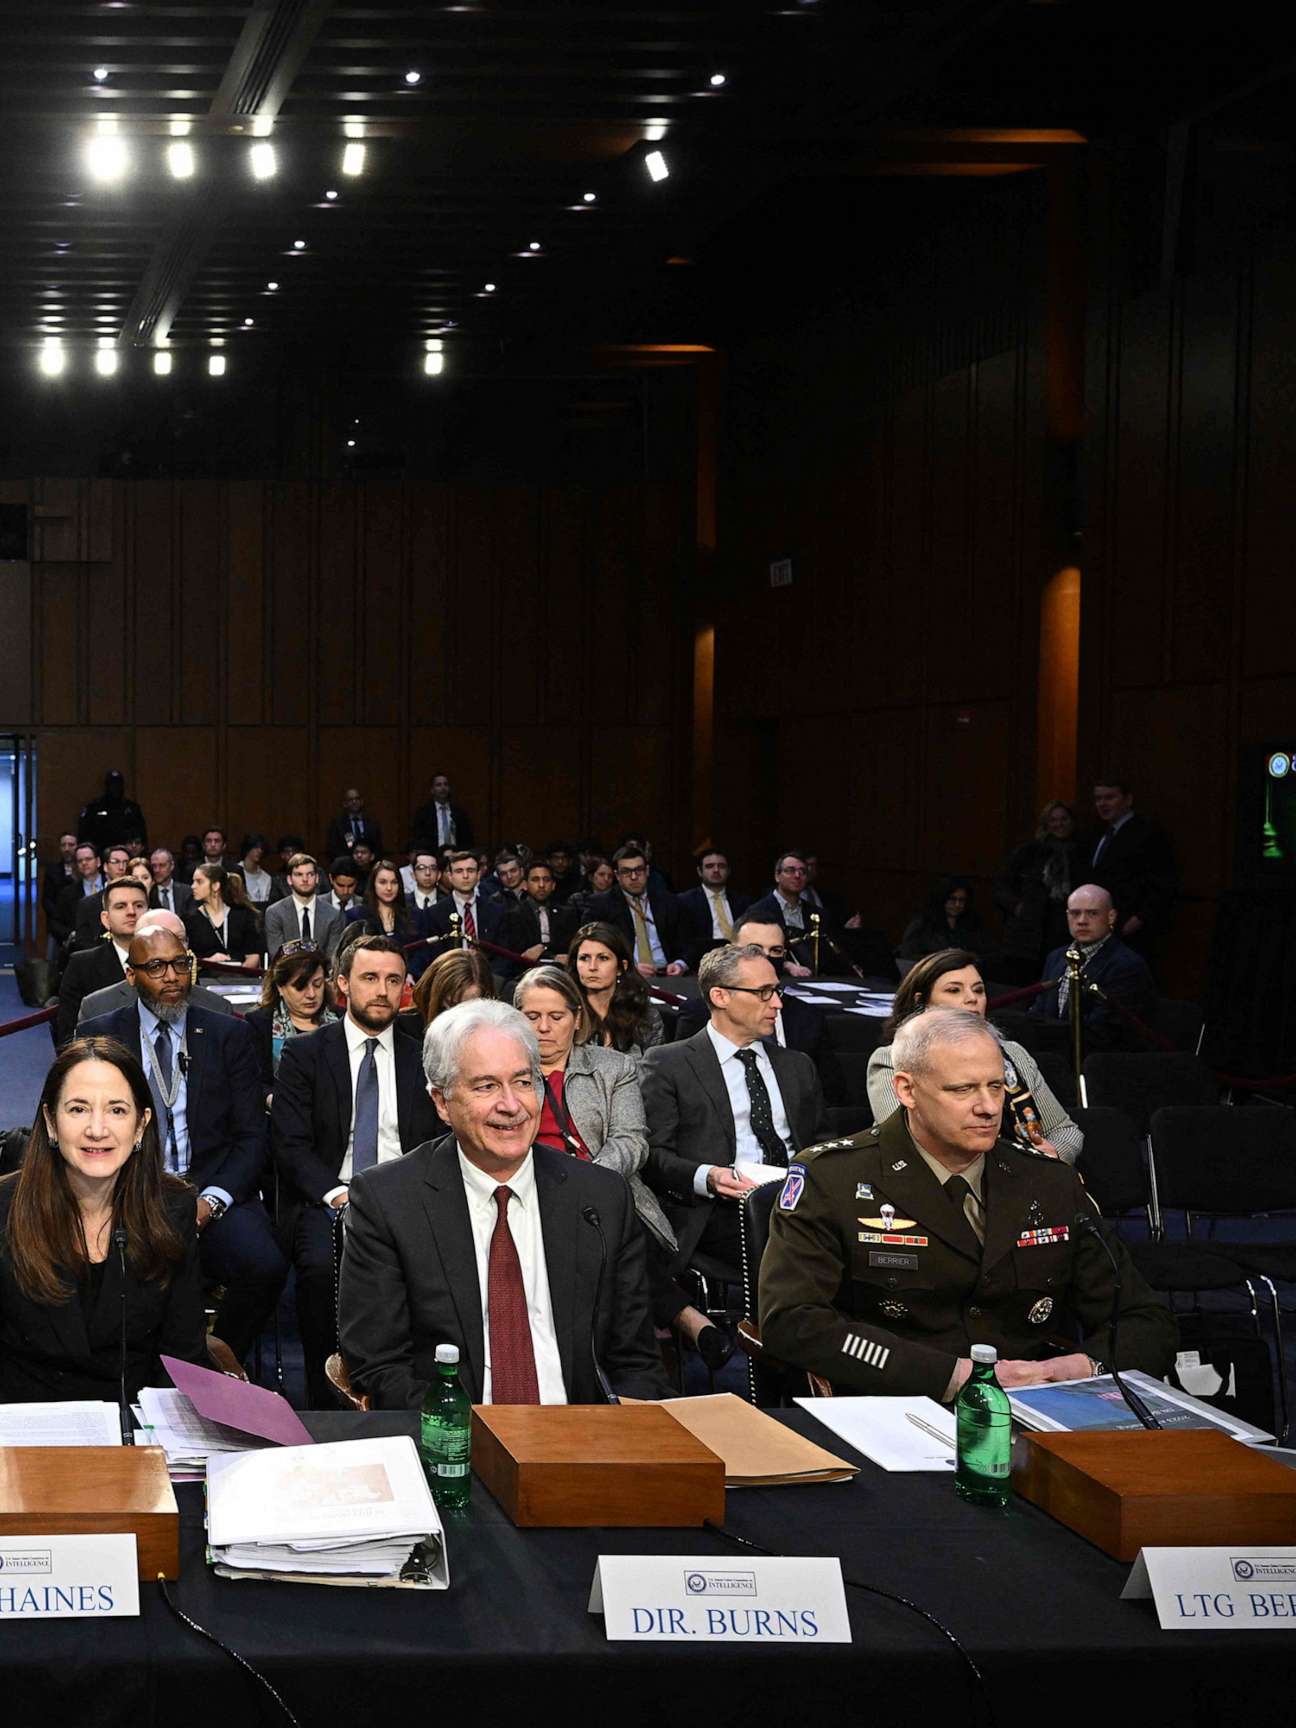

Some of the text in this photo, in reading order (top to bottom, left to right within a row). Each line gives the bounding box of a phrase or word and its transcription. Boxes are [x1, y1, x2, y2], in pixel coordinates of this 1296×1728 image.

[877, 1256, 910, 1266] BERRIER
[1175, 1593, 1235, 1617] LTG
[631, 1608, 819, 1637] DIR. BURNS
